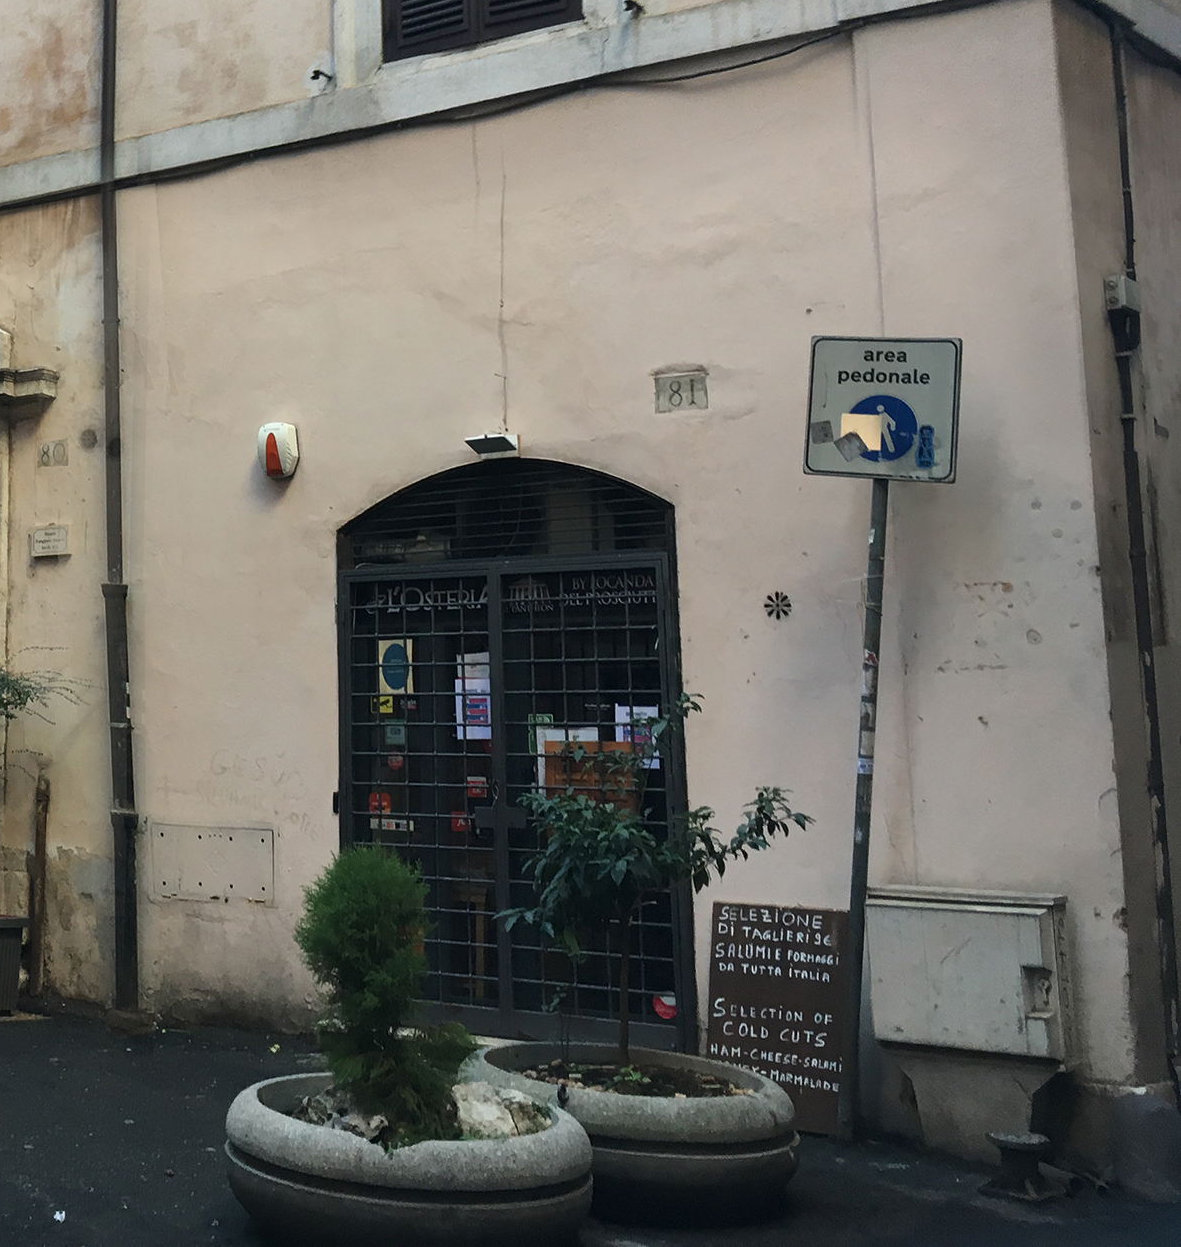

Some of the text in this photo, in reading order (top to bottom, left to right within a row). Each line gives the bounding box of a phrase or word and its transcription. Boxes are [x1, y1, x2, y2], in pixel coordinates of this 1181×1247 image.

[863, 348, 908, 364] area
[837, 367, 931, 385] pedonale
[668, 379, 697, 407] 81
[40, 443, 67, 465] 80
[572, 576, 586, 590] BY
[585, 590, 656, 606] PROSCIUTT
[719, 905, 823, 929] SELEZIONE
[718, 921, 734, 936] DI
[742, 925, 810, 943] TAGLIERI
[787, 949, 839, 965] FORMAGGI
[719, 962, 830, 982] DA TUTTA ITALIA
[713, 997, 833, 1025] SELECTION OF
[723, 1020, 827, 1047] COLD CUTS
